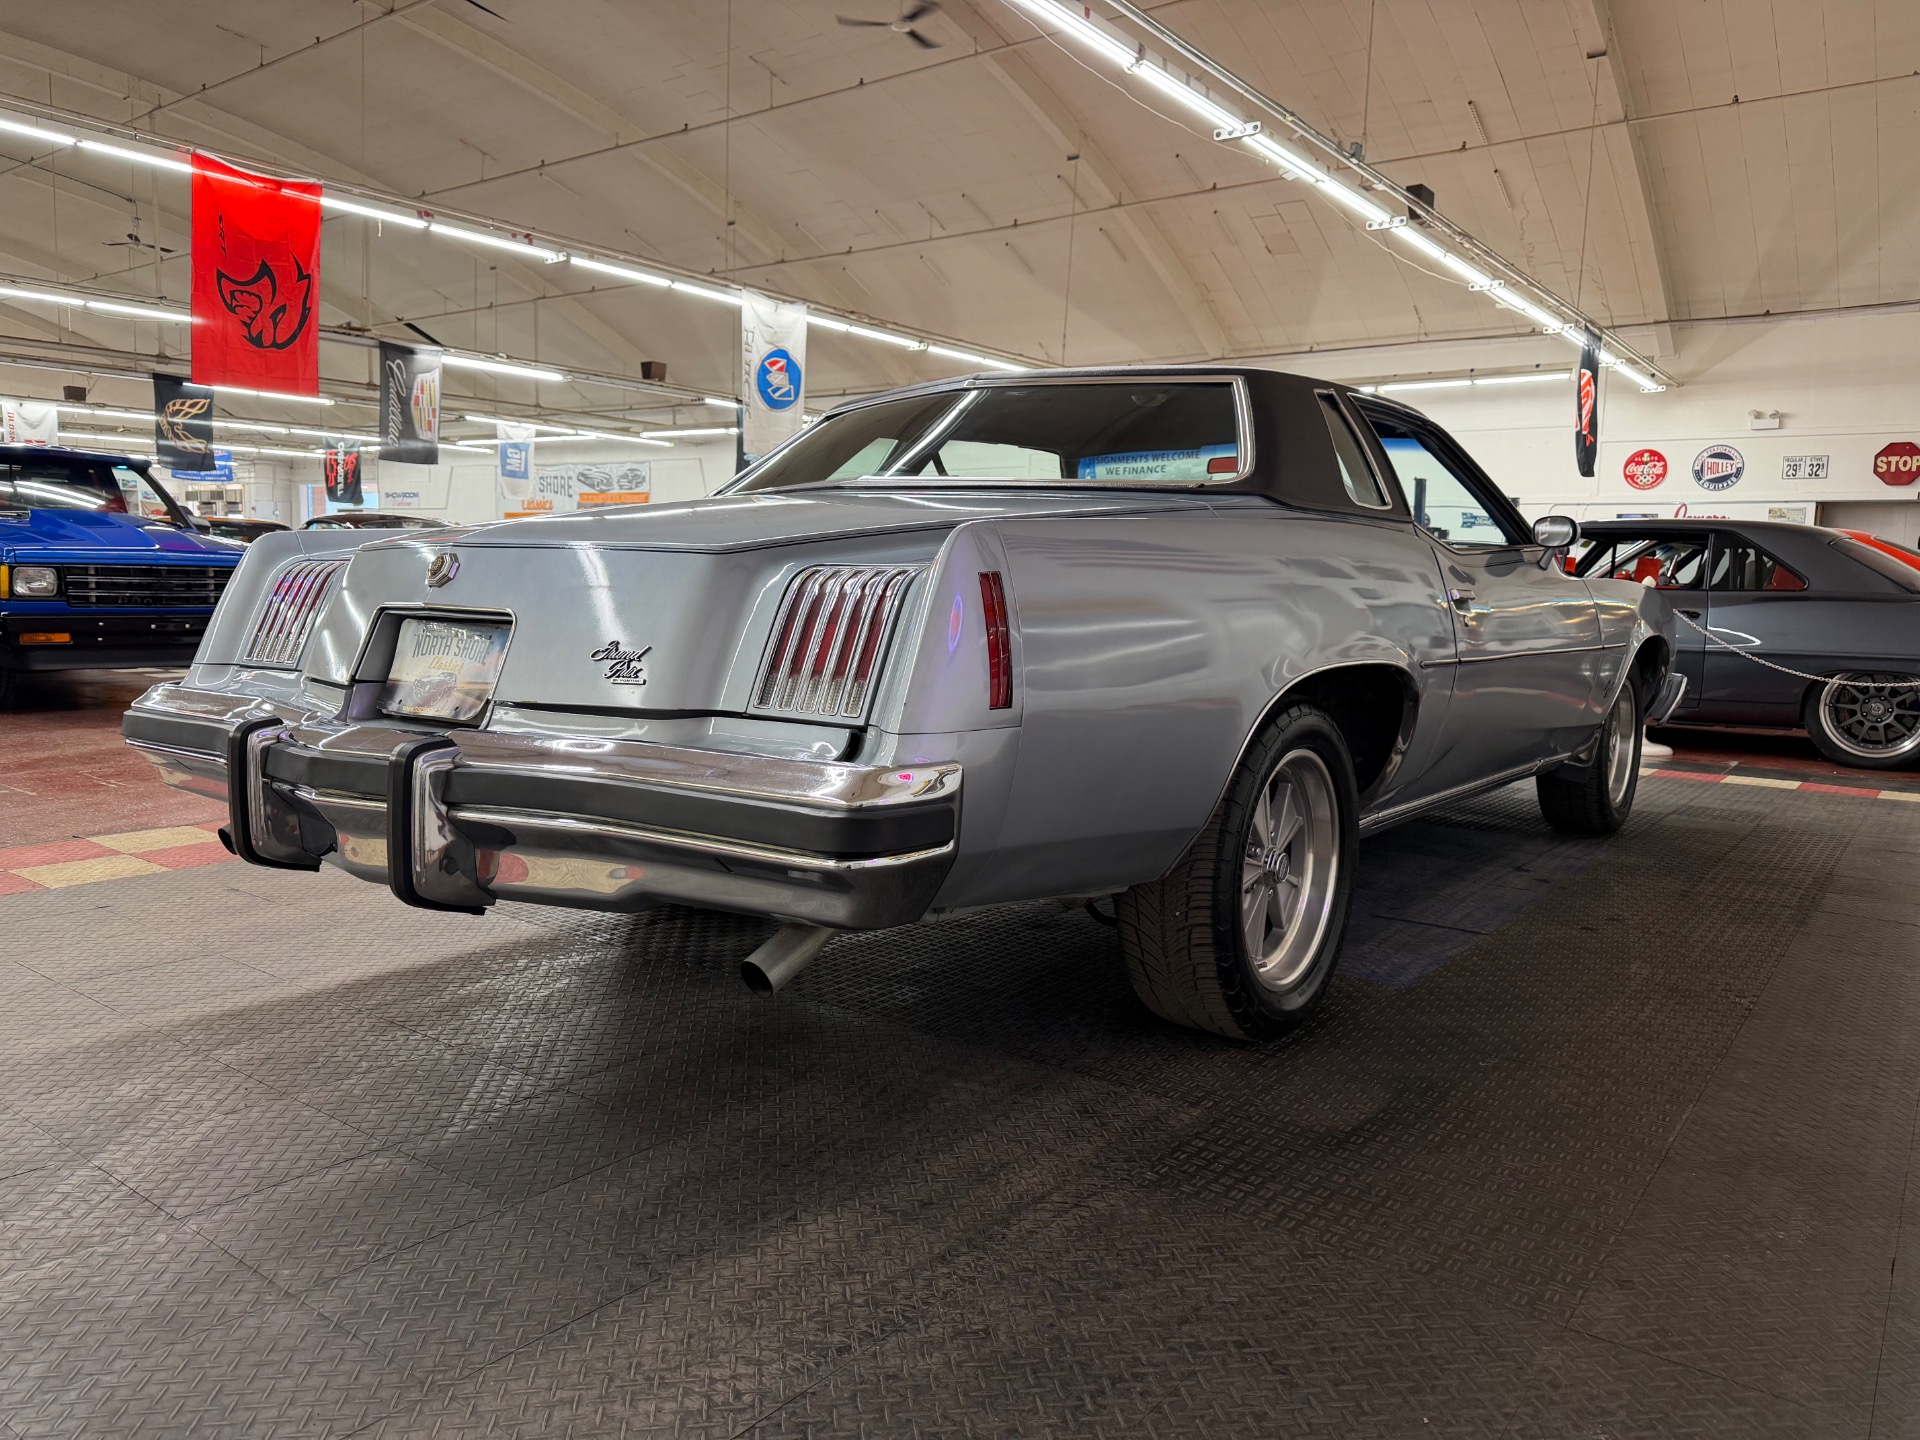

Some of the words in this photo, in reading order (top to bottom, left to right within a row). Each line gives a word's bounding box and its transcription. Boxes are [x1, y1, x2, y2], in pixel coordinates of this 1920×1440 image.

[743, 328, 755, 420] BUICK
[385, 359, 406, 447] Cadillac
[506, 448, 523, 471] GM
[1152, 450, 1200, 462] WELCOME
[1876, 455, 1920, 473] STOP
[1106, 466, 1120, 475] WE
[1122, 465, 1167, 475] FINANCE
[1706, 461, 1735, 476] HOLLEY
[538, 475, 573, 499] SHORE
[412, 633, 454, 658] NORTH
[453, 637, 495, 666] SHORE
[590, 640, 652, 661] Grand
[603, 660, 643, 679] Prix
